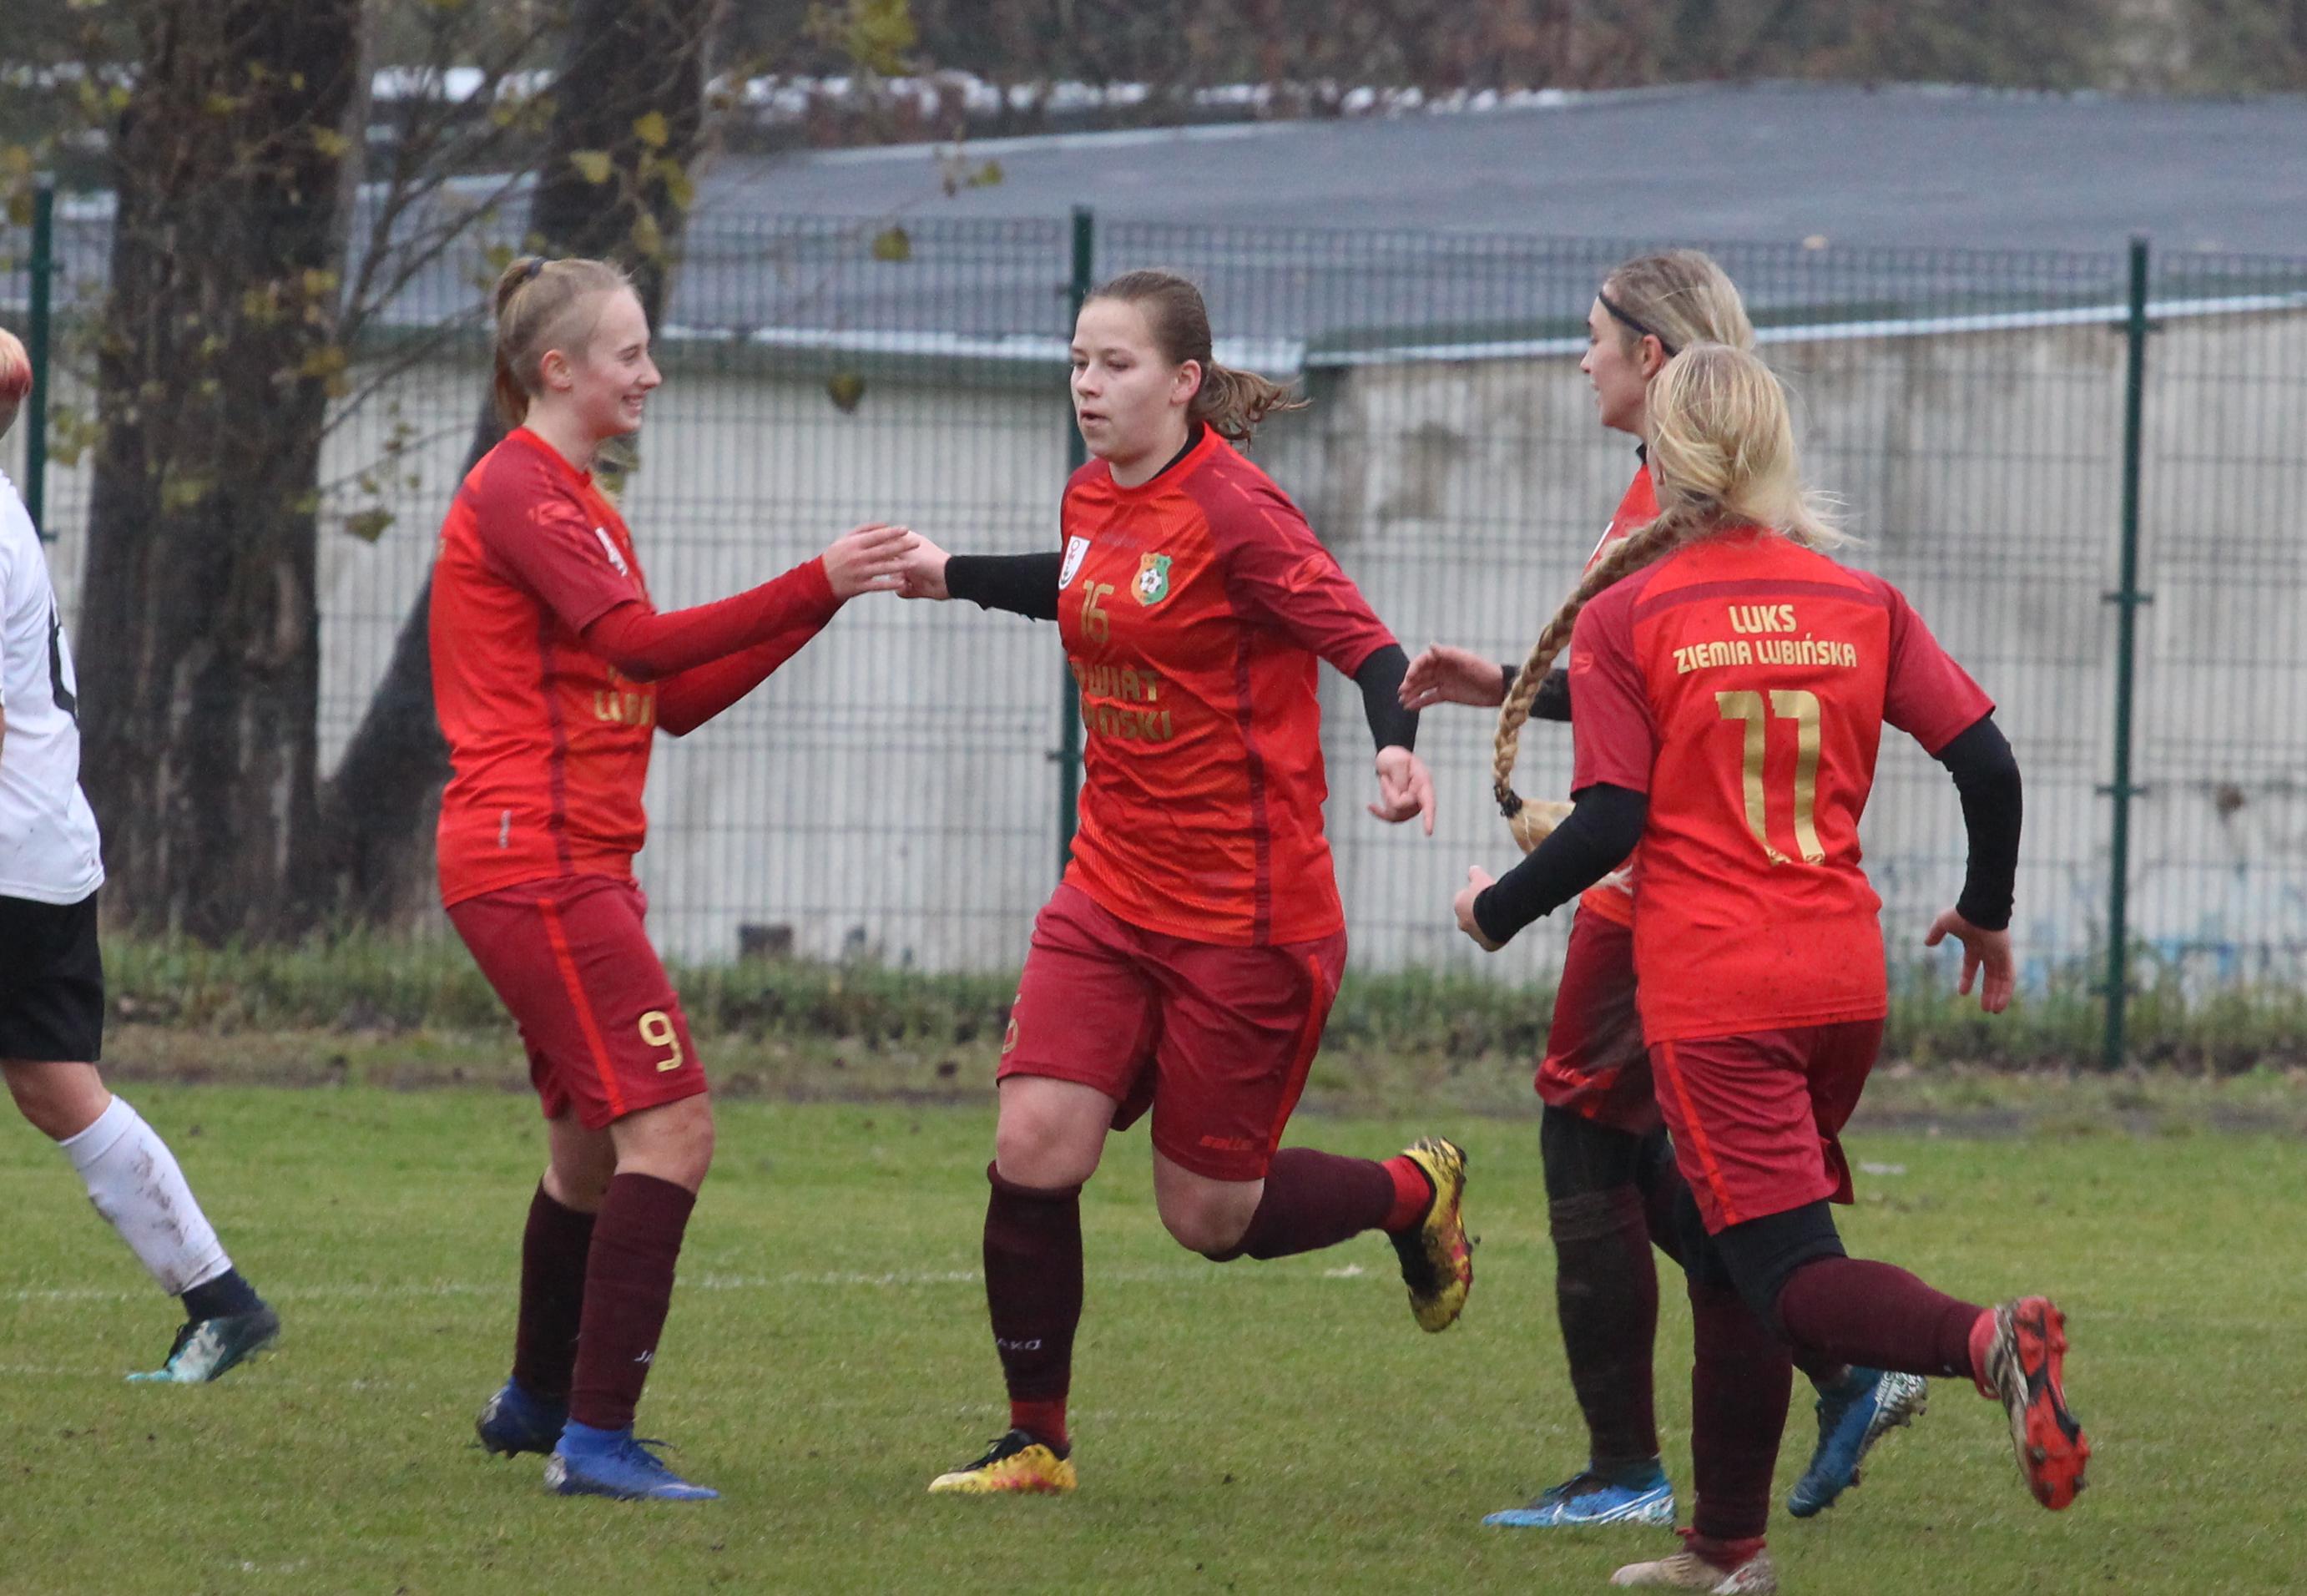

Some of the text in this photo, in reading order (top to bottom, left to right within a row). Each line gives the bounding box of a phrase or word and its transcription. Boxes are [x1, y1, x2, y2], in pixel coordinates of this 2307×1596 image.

[1081, 579, 1115, 644] 16
[1729, 604, 1797, 634] LUKS
[1673, 632, 1857, 674] ZIEMIA LUBIŃSKA
[639, 1010, 684, 1073] 9
